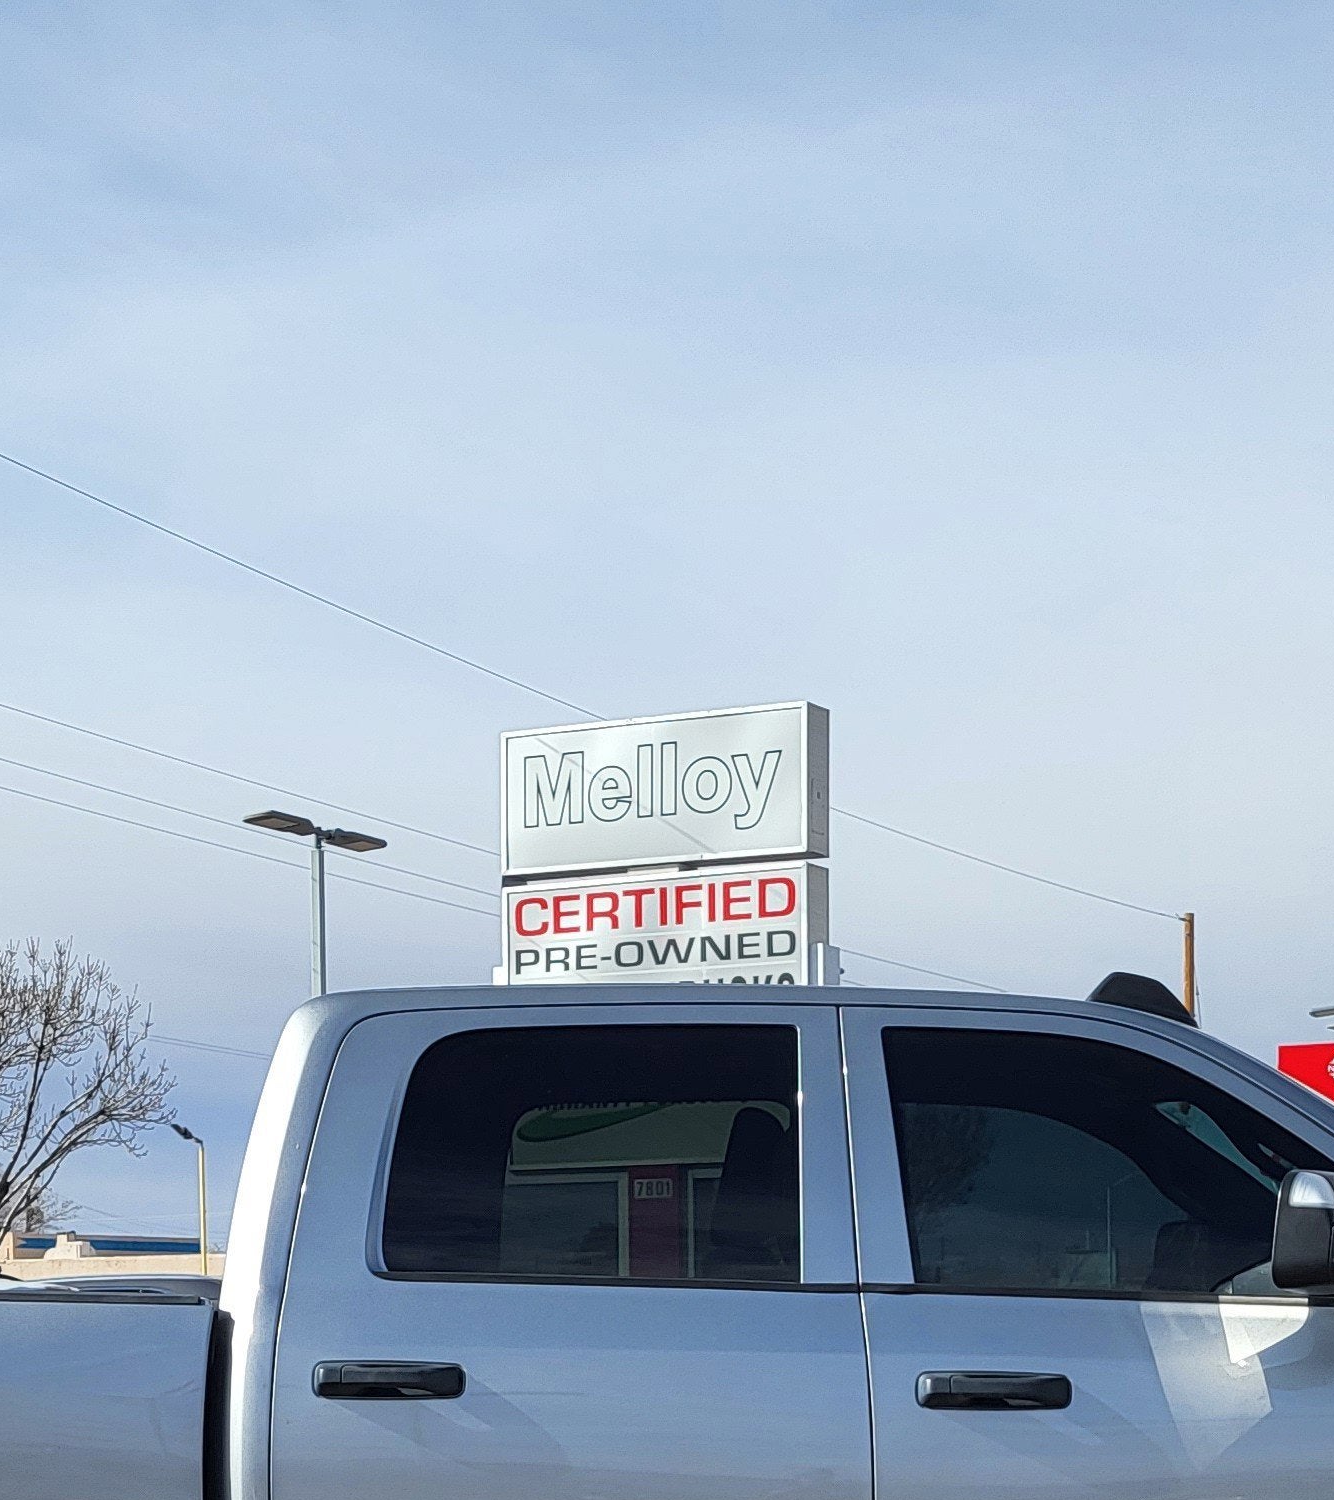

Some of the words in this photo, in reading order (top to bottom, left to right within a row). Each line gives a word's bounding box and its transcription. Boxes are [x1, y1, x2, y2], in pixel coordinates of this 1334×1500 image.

[524, 741, 783, 830] Melloy
[515, 877, 796, 936] CERTIFIED
[515, 929, 796, 975] PRE-OWNED
[636, 1181, 671, 1196] 7801
